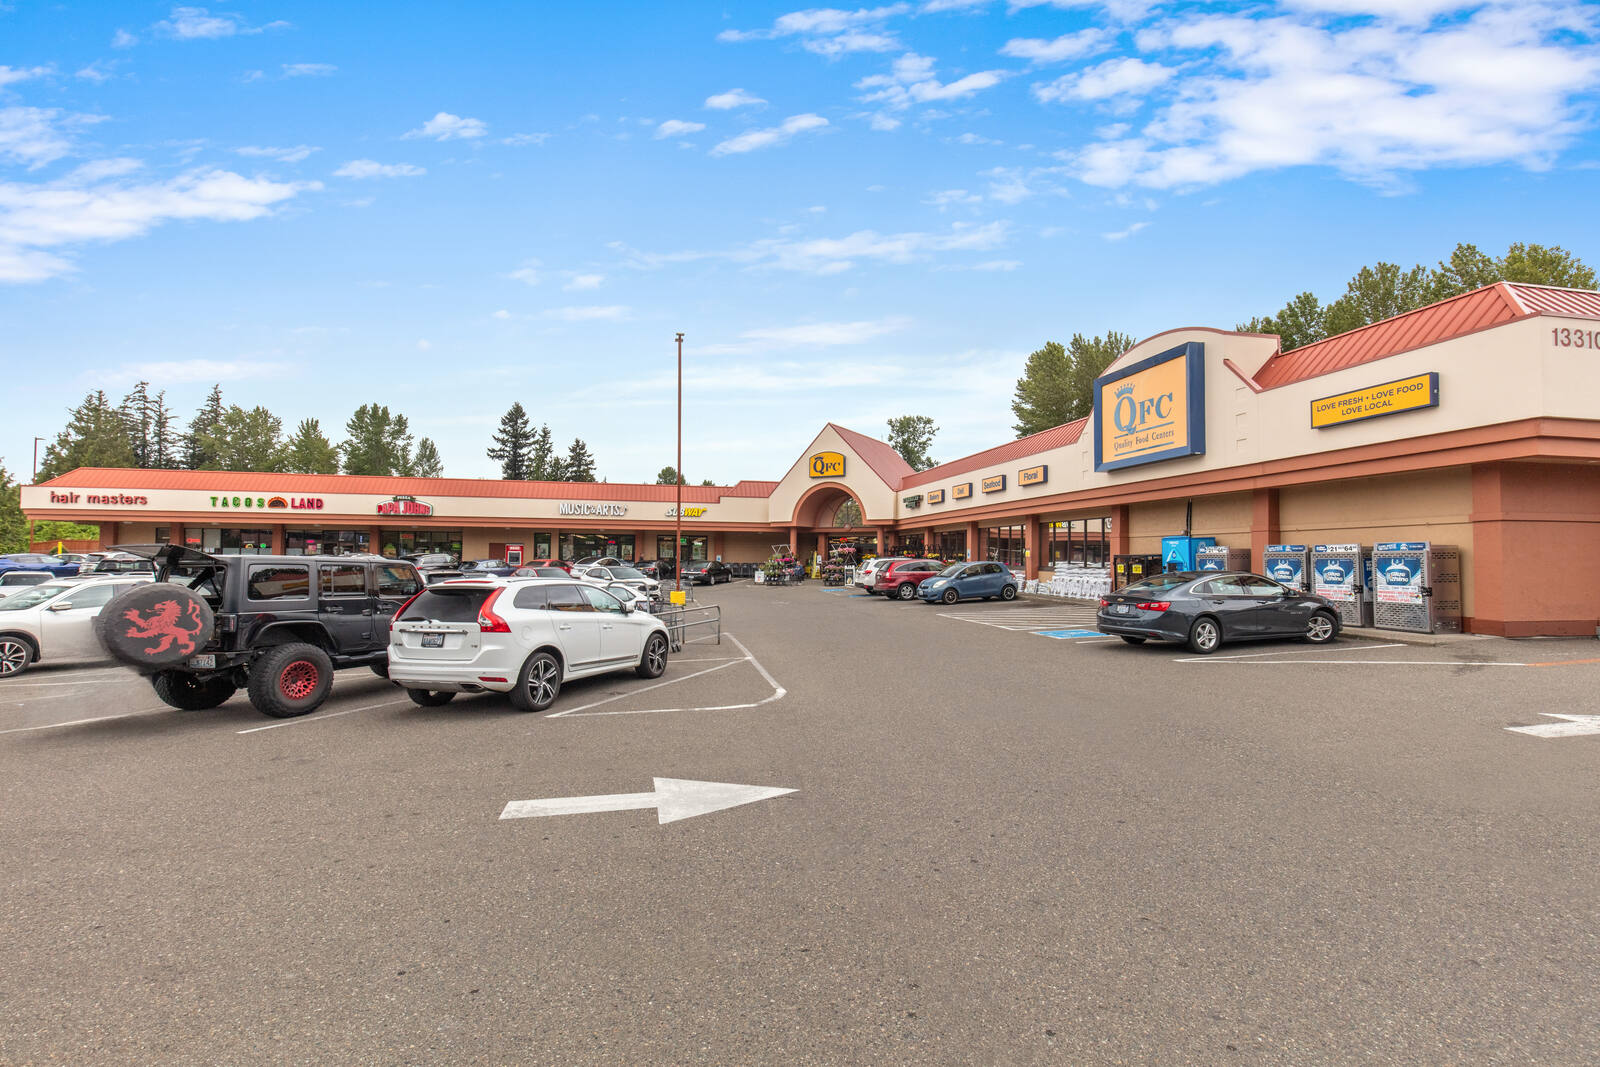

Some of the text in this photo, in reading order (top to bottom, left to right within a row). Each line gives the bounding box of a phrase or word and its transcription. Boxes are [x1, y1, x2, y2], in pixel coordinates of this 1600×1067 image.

[1316, 382, 1424, 412] LOVE FRESH LOVE FOOD
[1114, 392, 1173, 434] QFC
[1341, 399, 1393, 416] LOVE LOCAL
[1114, 429, 1175, 451] Quality Food Centers
[813, 459, 841, 475] QFC
[1023, 470, 1039, 481] Floral
[983, 479, 1001, 490] Seafood
[49, 490, 148, 505] hair masters
[210, 496, 324, 510] TACOS LAND
[377, 501, 401, 514] PAPA
[665, 507, 707, 517] SUBWAY
